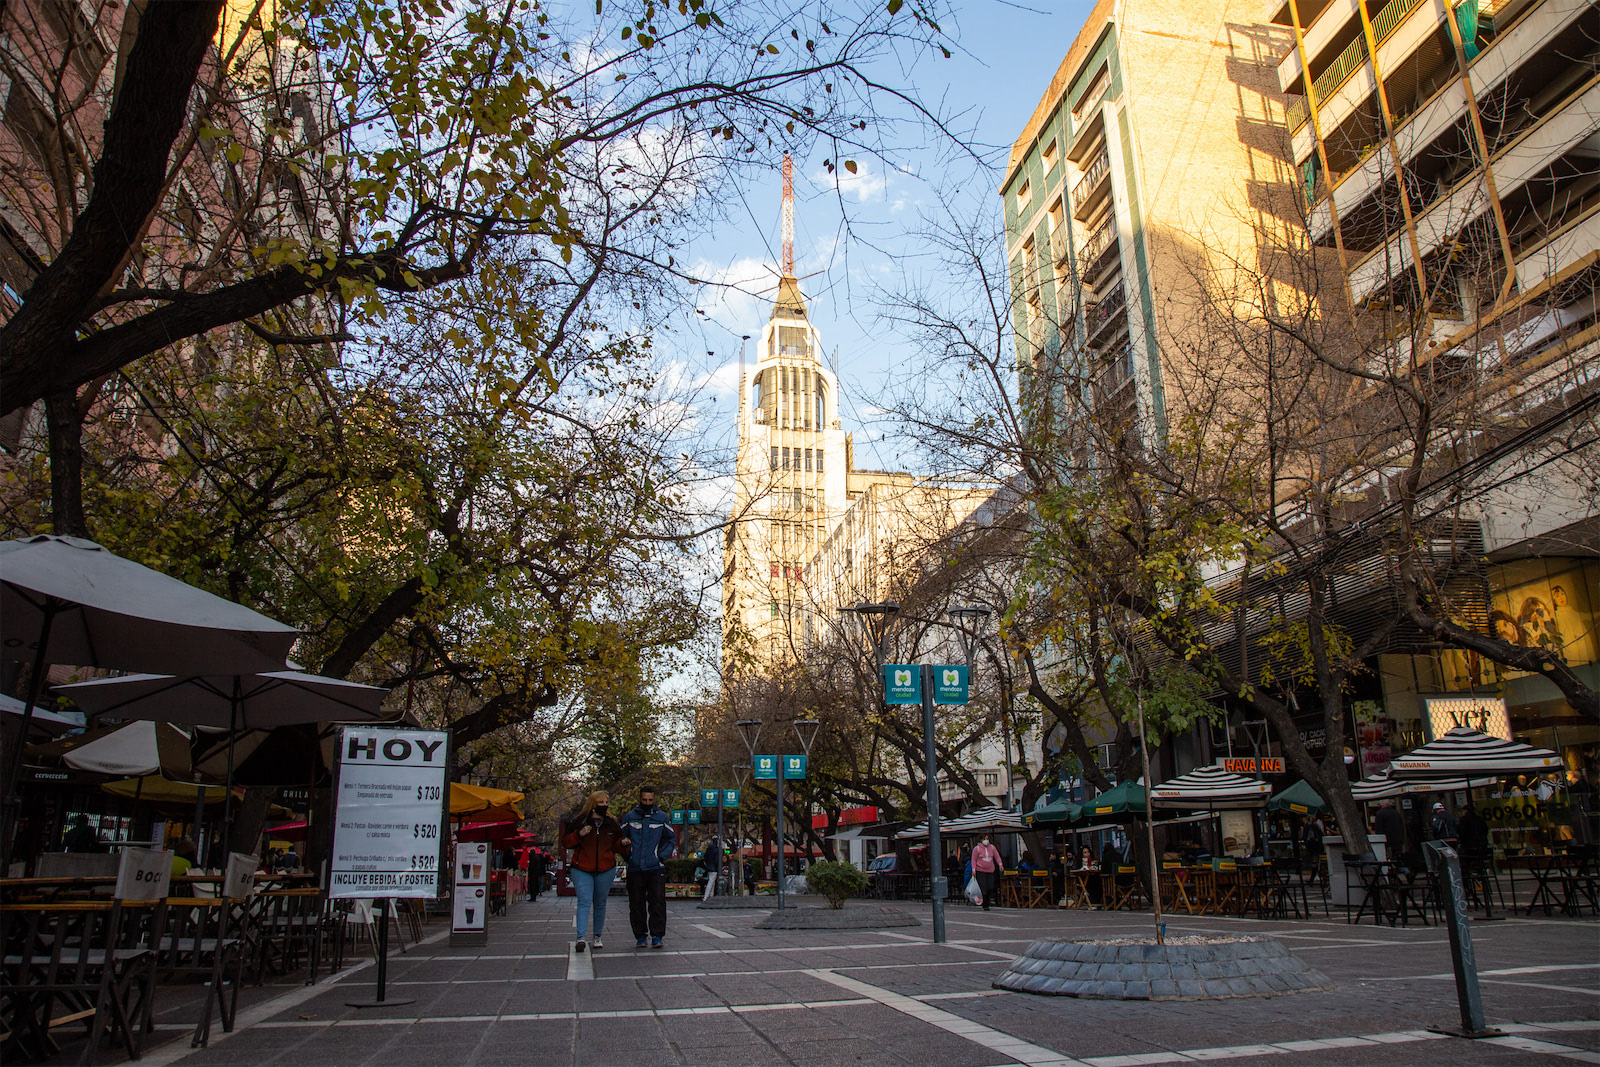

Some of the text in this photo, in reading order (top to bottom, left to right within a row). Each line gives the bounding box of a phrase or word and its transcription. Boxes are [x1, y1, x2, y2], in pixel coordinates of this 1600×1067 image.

[348, 737, 444, 762] HOY
[417, 785, 440, 802] $ 730
[413, 823, 438, 840] $ 520
[411, 855, 435, 870] $ 520
[334, 873, 434, 885] INCLUYE BEBIDA Y POSTRE
